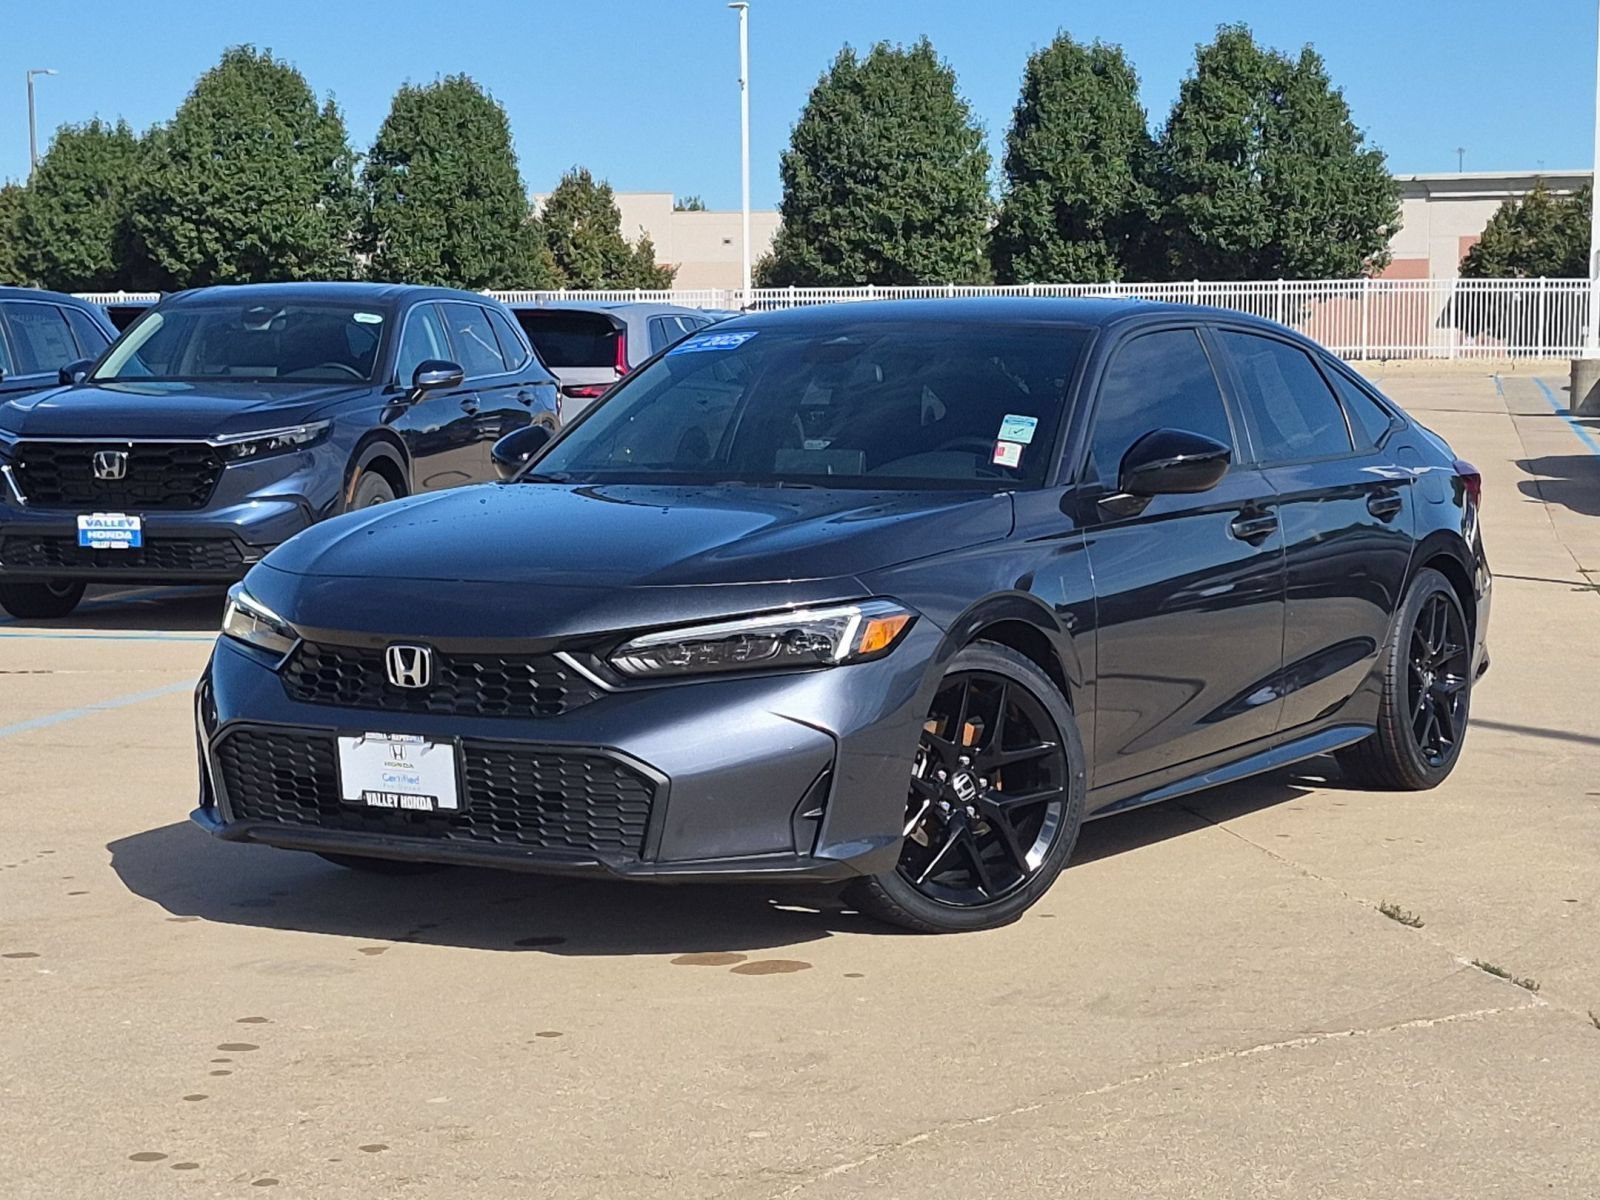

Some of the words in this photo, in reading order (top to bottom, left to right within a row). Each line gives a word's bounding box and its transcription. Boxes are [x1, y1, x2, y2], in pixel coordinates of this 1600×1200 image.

[85, 519, 134, 527] VALLEY
[87, 530, 133, 540] HONDA
[365, 792, 398, 808] VALLEY
[400, 794, 433, 811] HONDA
